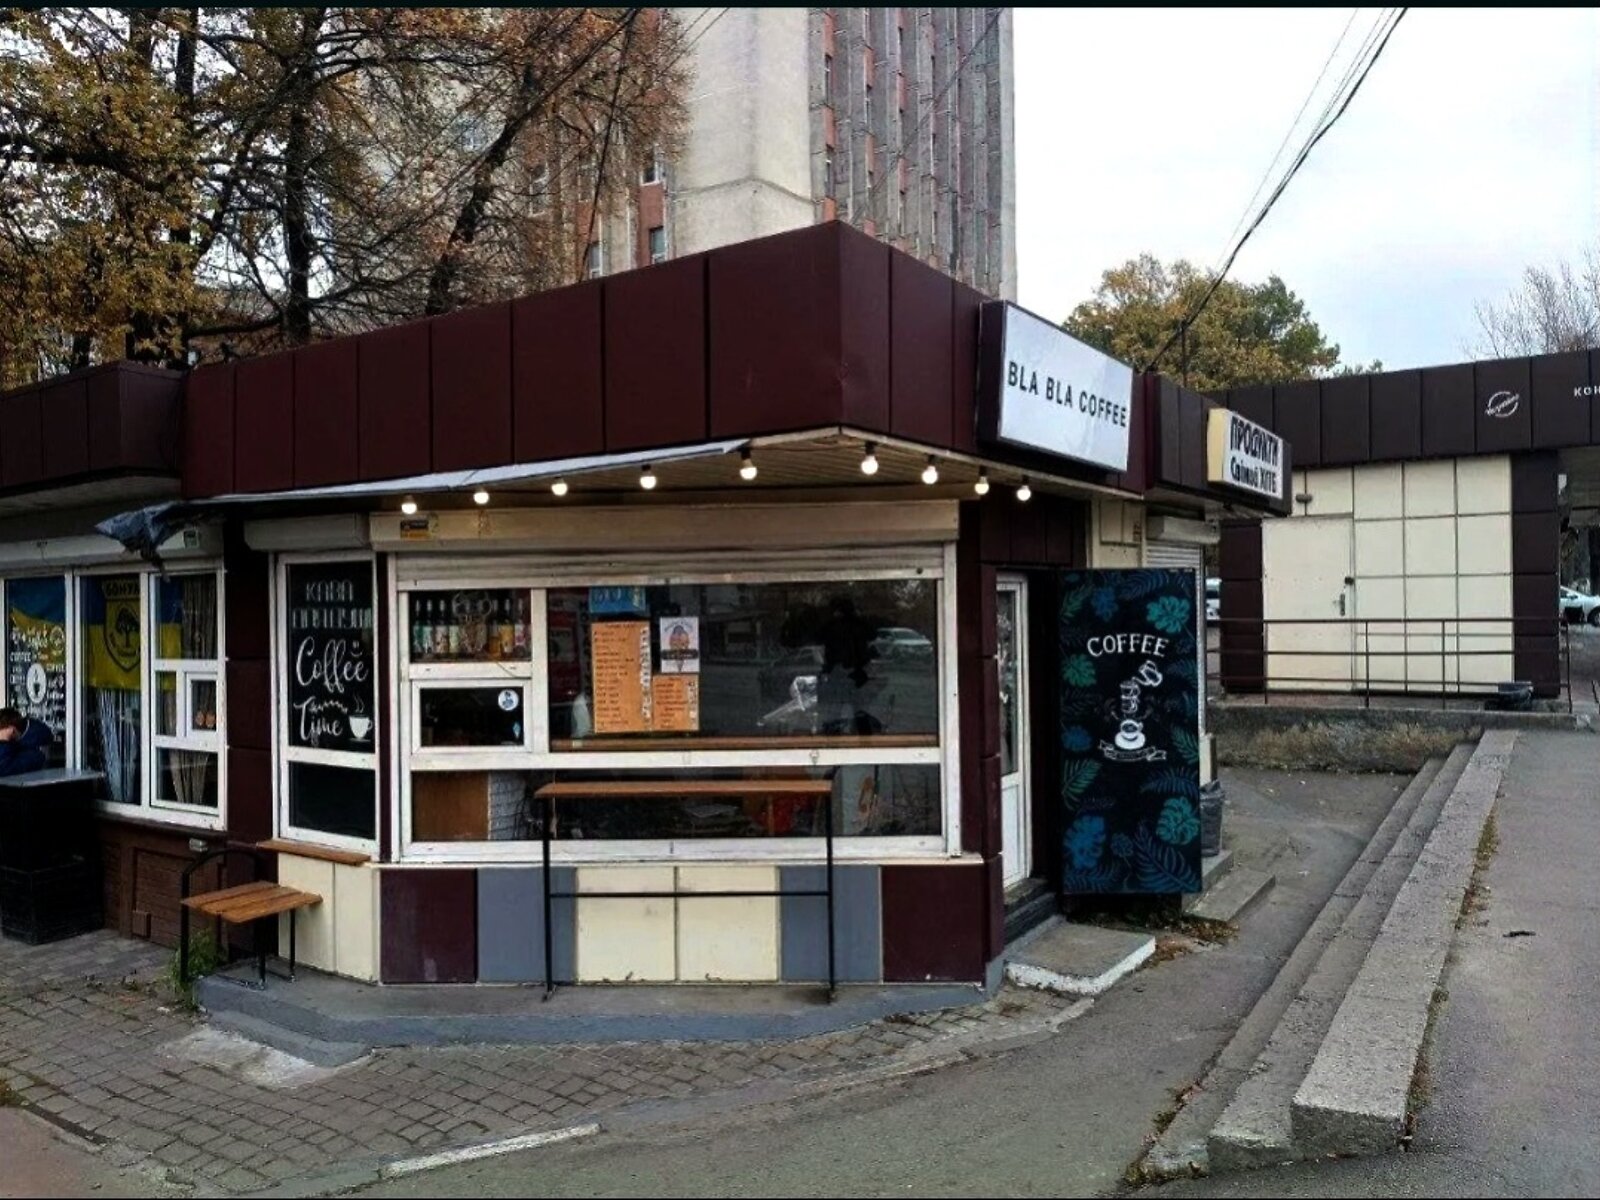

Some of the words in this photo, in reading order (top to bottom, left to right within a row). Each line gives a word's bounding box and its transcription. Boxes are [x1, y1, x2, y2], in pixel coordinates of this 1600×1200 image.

[1008, 361, 1038, 395] BLA
[1046, 377, 1073, 408] BLA
[1079, 390, 1127, 427] COFFEE
[296, 635, 369, 694] Coffee
[1086, 633, 1170, 658] COFFEE
